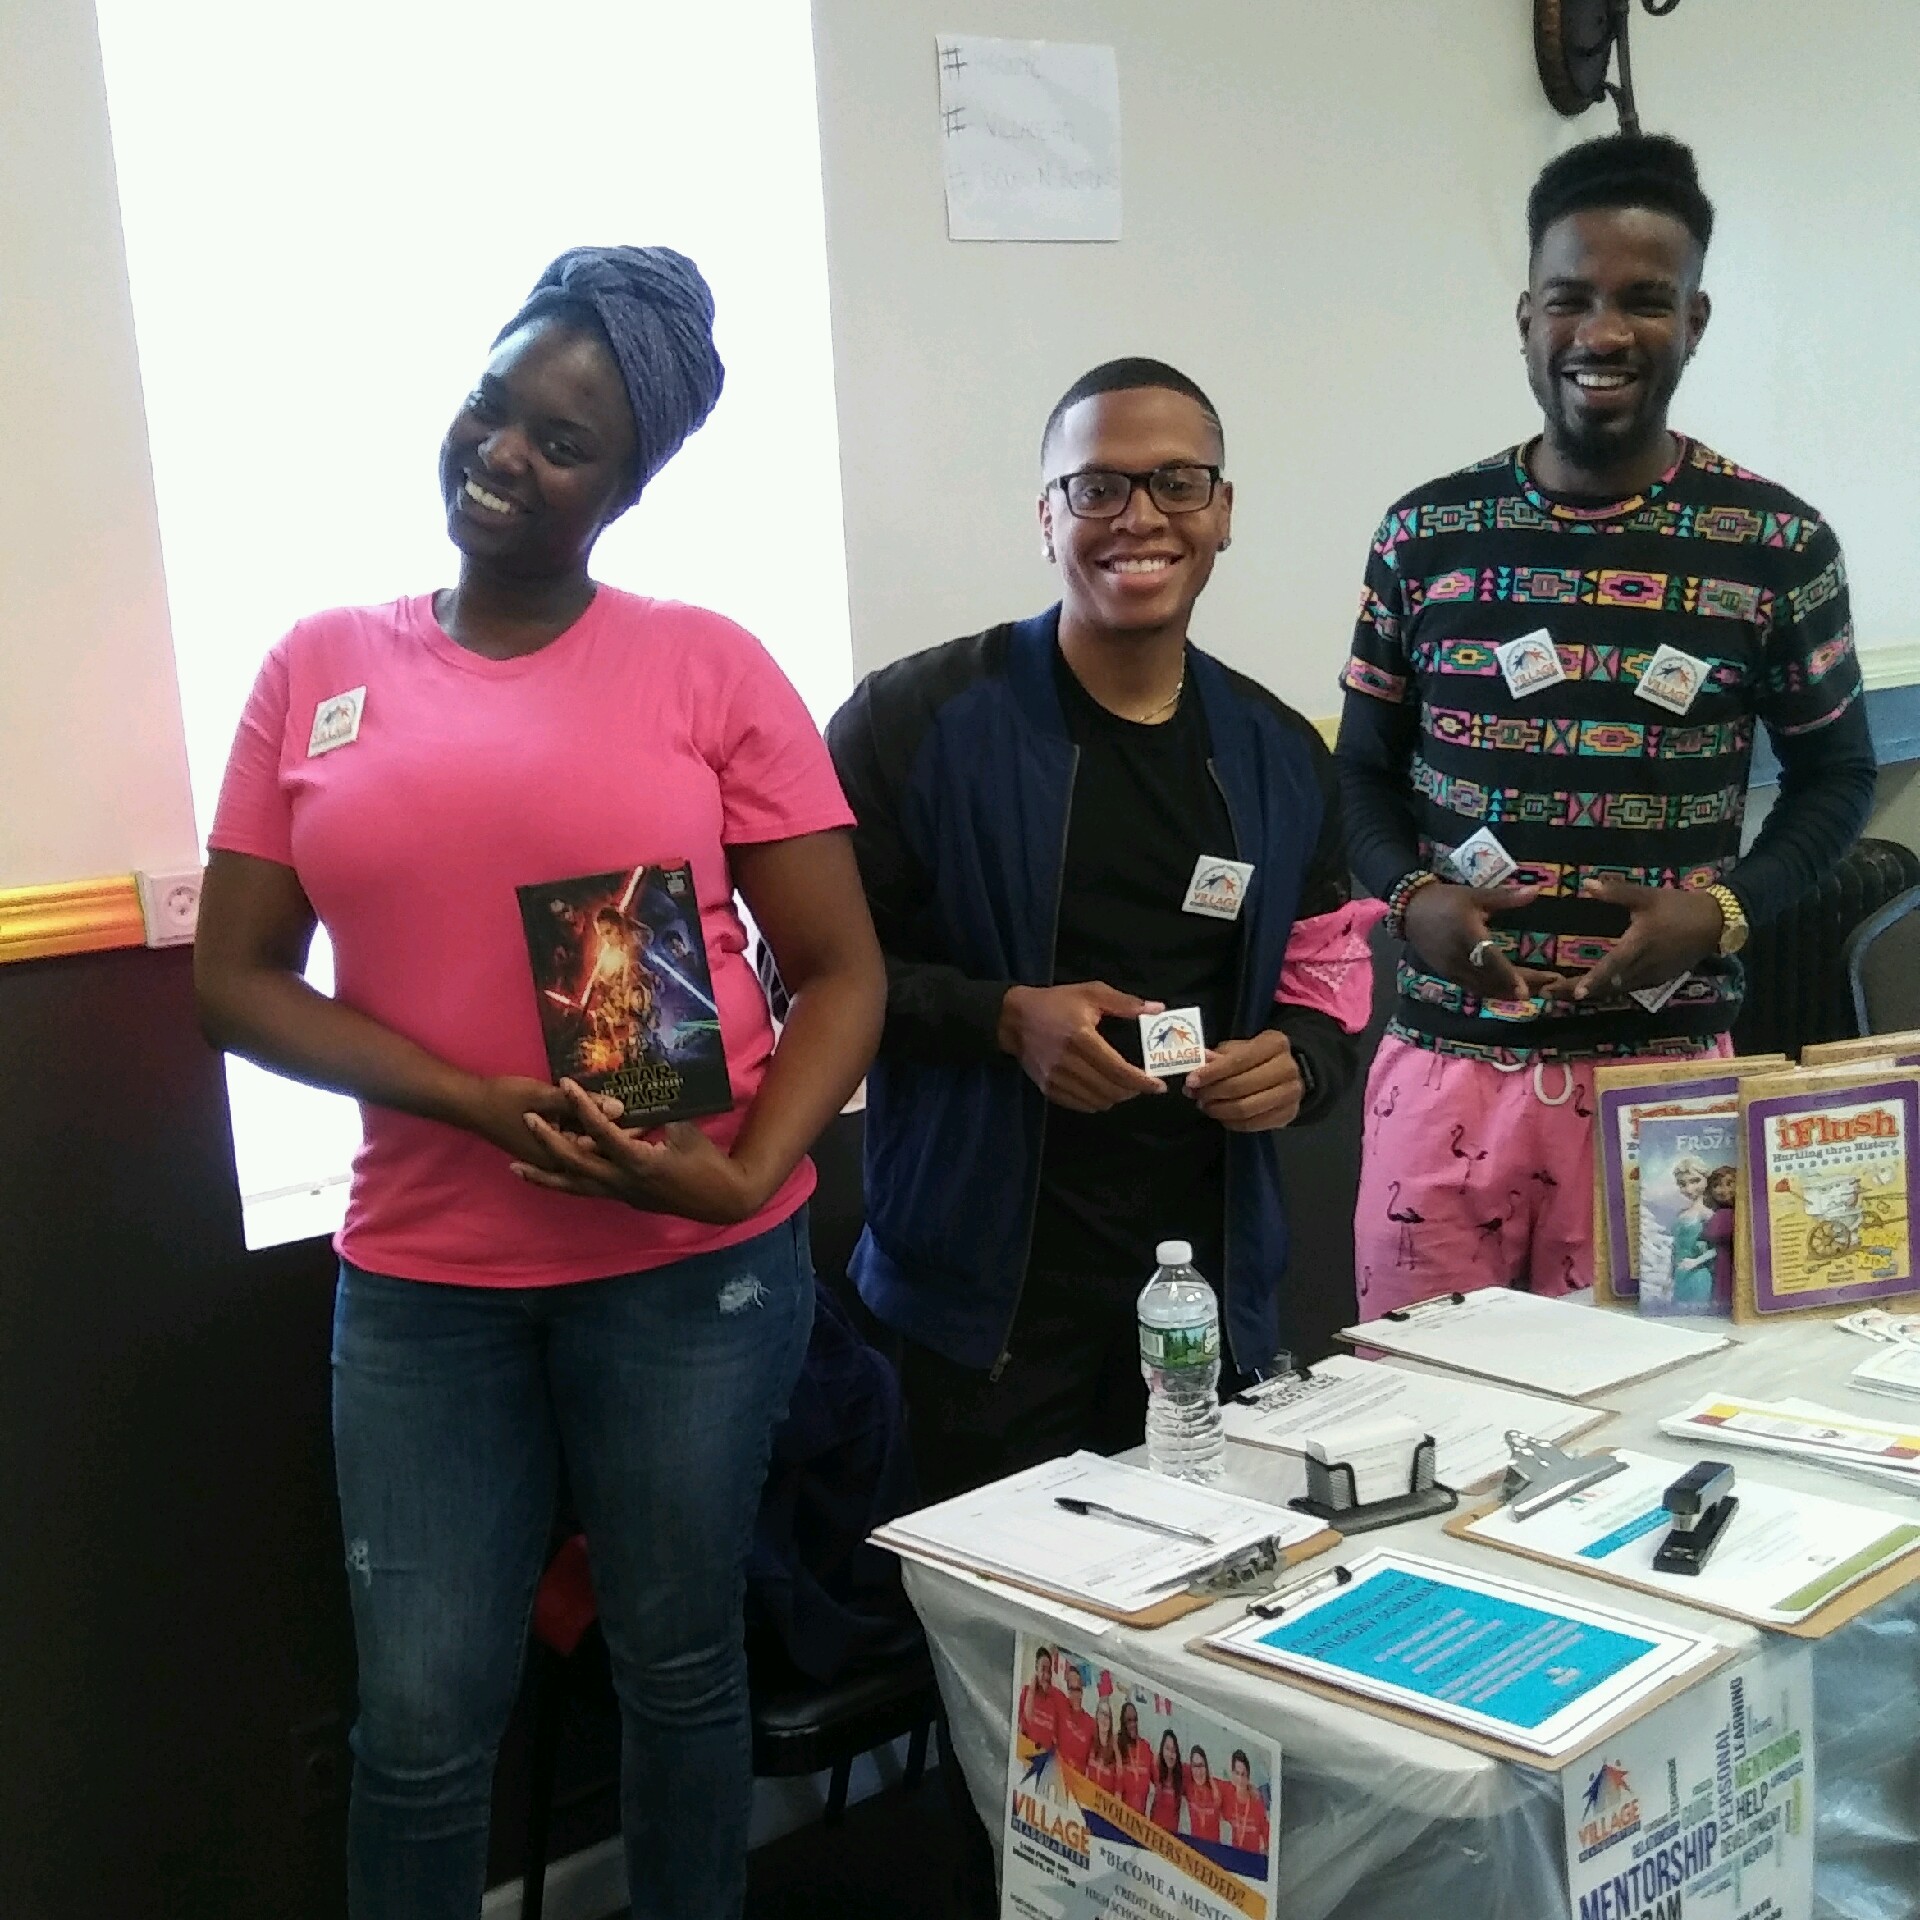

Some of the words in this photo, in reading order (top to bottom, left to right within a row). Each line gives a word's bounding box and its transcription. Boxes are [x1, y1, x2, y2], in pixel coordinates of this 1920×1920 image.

[1149, 1046, 1201, 1063] VILLAGE
[1775, 1106, 1899, 1151] iFlush
[1012, 1789, 1092, 1856] VILLAGE
[1578, 1799, 1640, 1849] VILLAGE
[1167, 1885, 1176, 1901] A
[1579, 1821, 1717, 1920] MENTORSHIP
